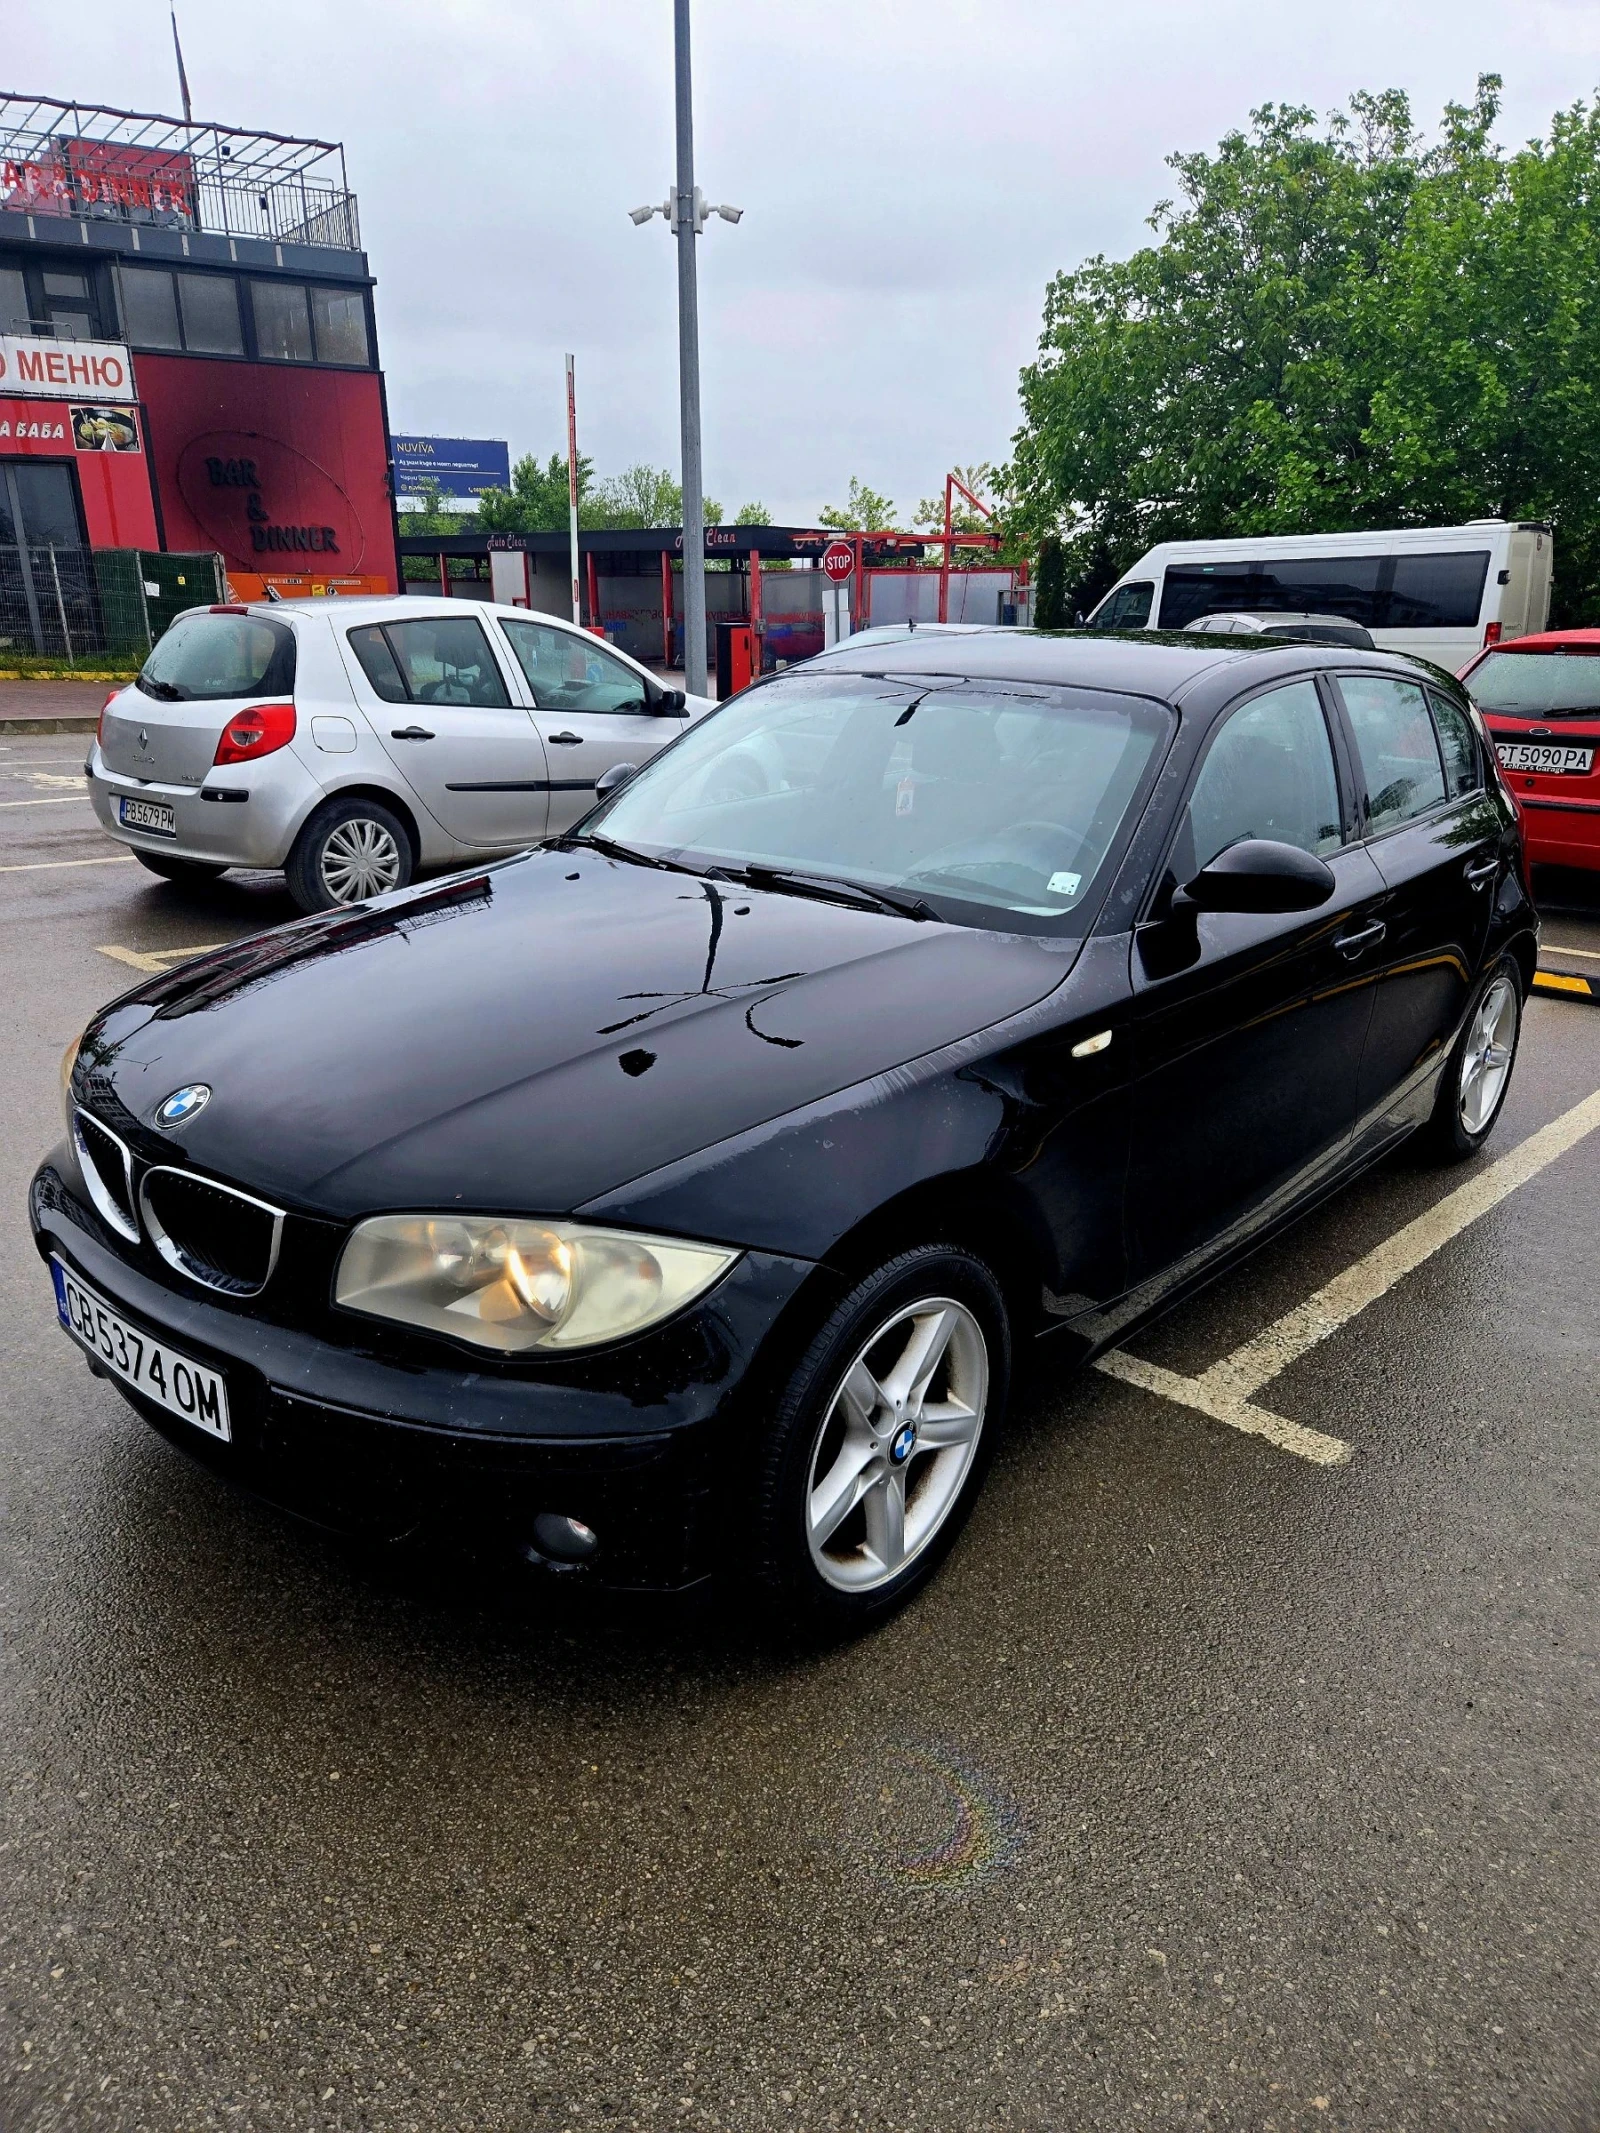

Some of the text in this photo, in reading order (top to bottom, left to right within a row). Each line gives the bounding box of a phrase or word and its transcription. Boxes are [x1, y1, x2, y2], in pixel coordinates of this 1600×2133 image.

[17, 350, 123, 388] МЕНЮ
[15, 421, 64, 439] БАБА
[206, 456, 262, 488] BAR
[247, 493, 269, 521] &
[250, 525, 341, 554] DINNER
[487, 533, 527, 550] Auto Clean
[706, 528, 736, 546] Clean
[827, 555, 851, 570] STOP
[1496, 745, 1587, 768] CT 5090 PA
[1535, 765, 1566, 774] Garage
[125, 801, 175, 830] PB 5679 PM
[67, 1282, 222, 1431] CB 5374 OM
